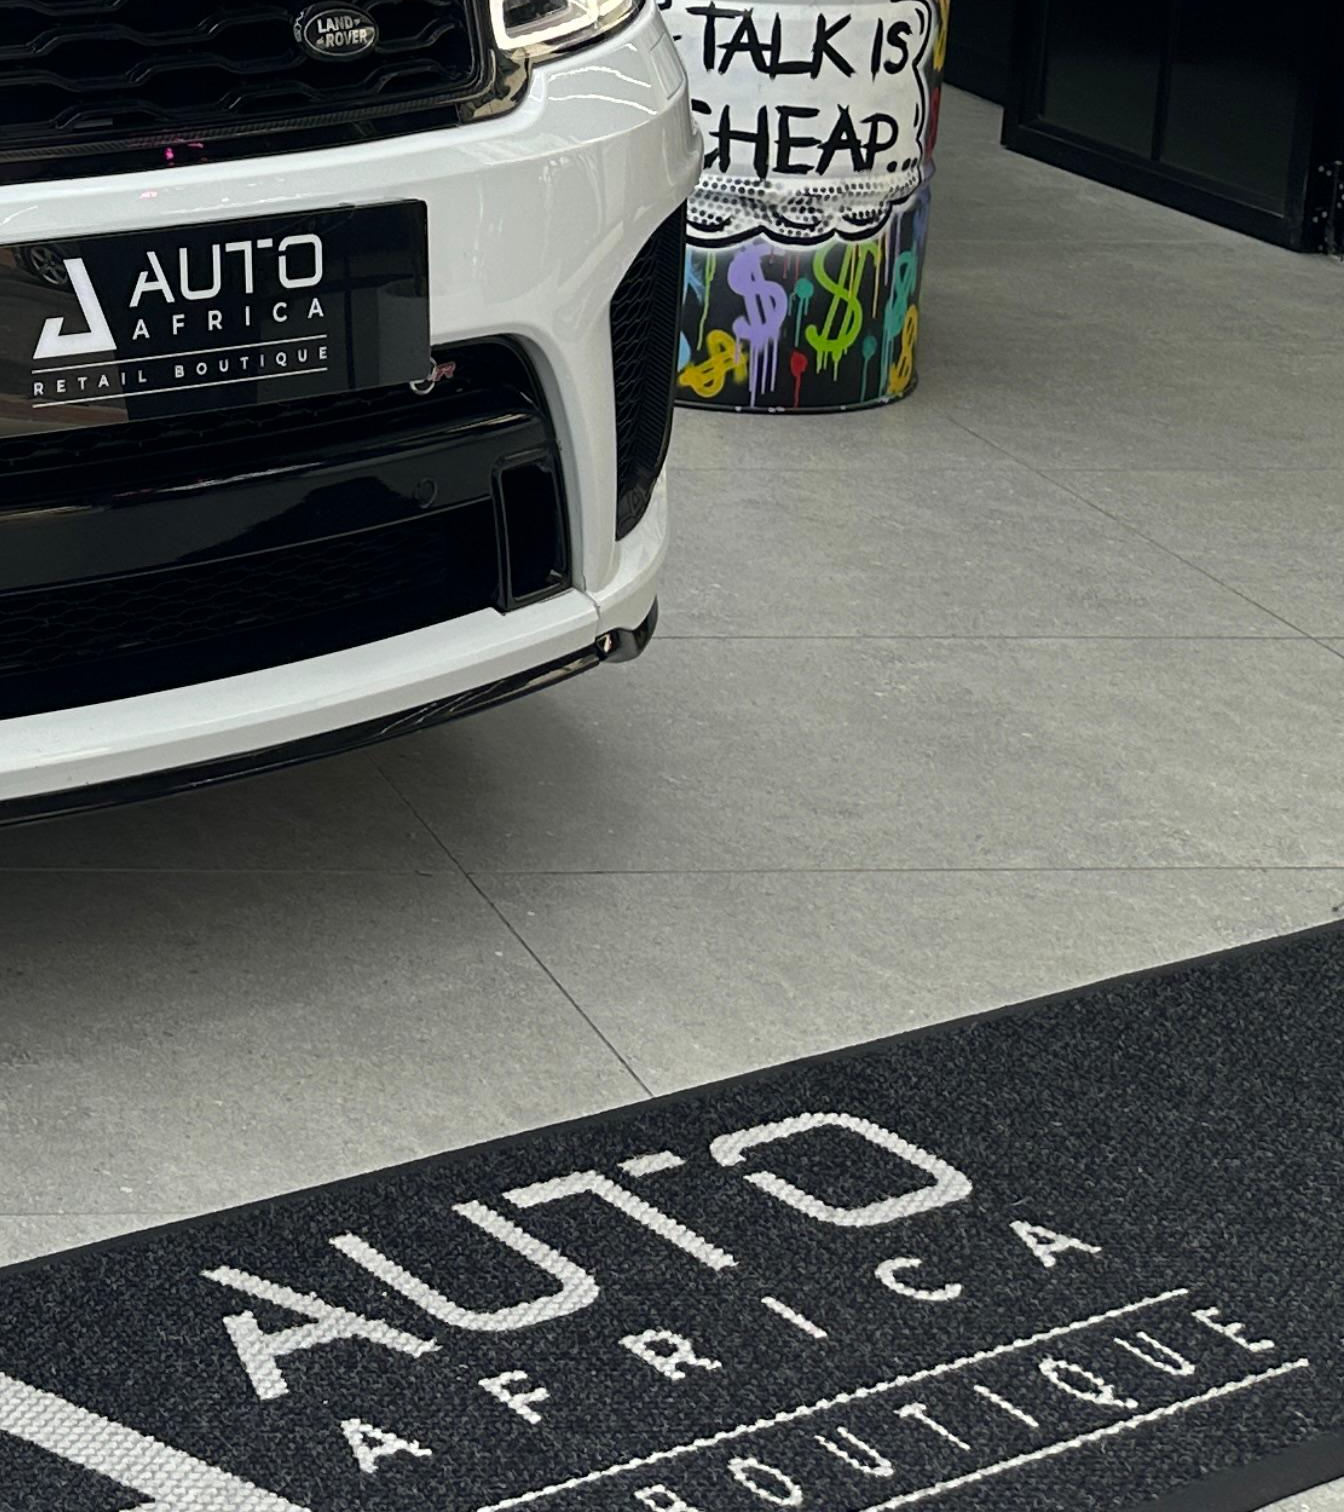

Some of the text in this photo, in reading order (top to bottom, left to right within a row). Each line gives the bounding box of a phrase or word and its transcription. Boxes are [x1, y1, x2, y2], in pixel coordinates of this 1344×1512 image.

[316, 15, 354, 34] LAND
[325, 28, 368, 48] ROVER
[685, 1, 913, 82] TALK IS
[129, 233, 323, 308] AUTO
[132, 297, 325, 340] AFRICA
[32, 346, 328, 396] RETAIL BOUTIQUE
[199, 1112, 973, 1402] AUTO
[340, 1220, 1103, 1473] AFRICA
